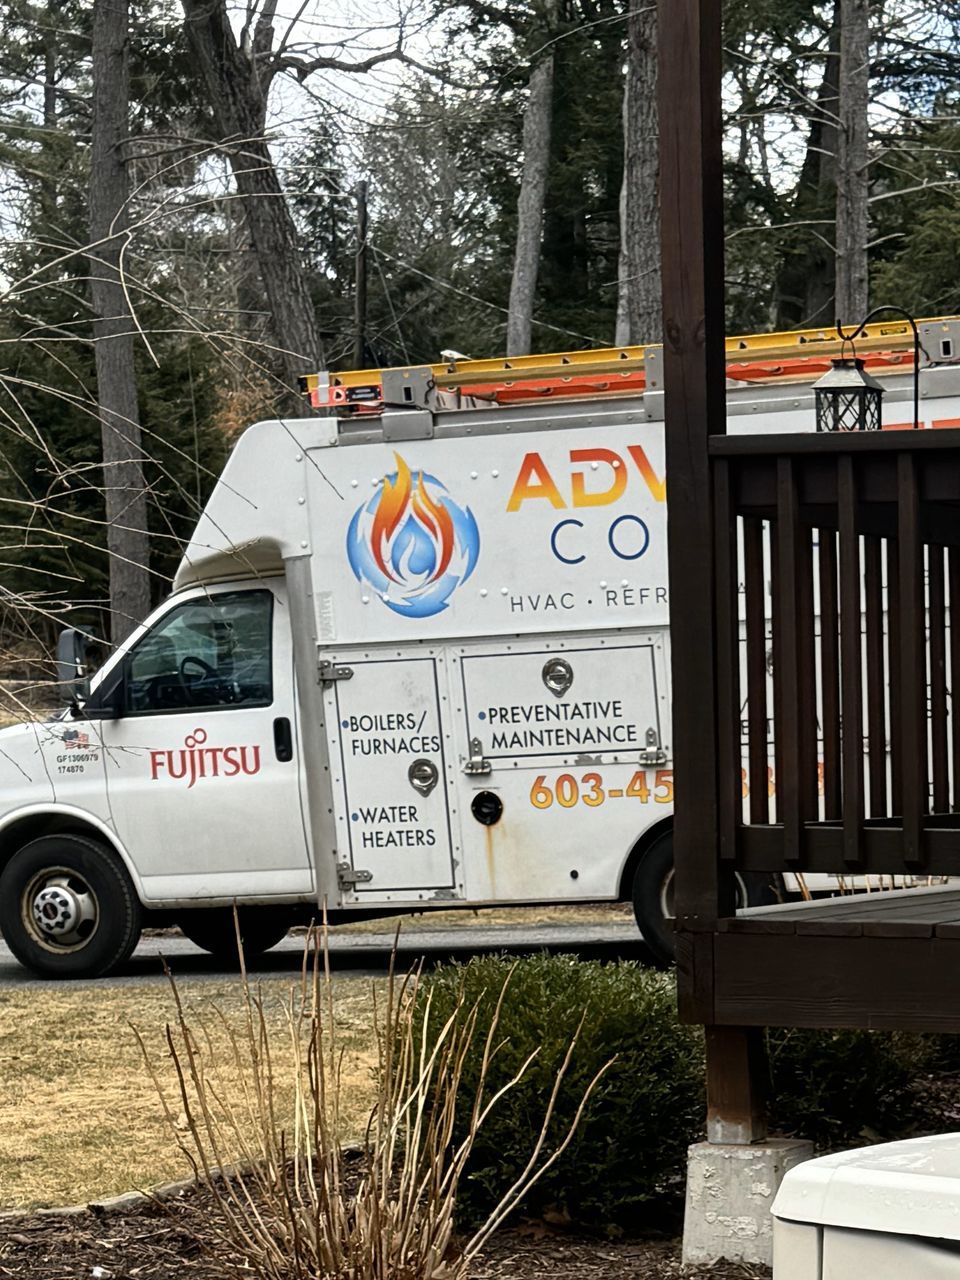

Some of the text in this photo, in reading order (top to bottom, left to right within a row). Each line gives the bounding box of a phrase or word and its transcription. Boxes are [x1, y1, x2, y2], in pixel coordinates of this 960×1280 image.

[510, 586, 668, 613] HVAC REFR
[349, 710, 428, 734] BOILERS/
[488, 700, 623, 725] PREVENTATIVE
[352, 735, 440, 756] FURNACES
[491, 724, 638, 750] MAINTENANCE
[150, 745, 260, 789] FUJITSU
[530, 769, 673, 809] 603-45
[359, 805, 419, 824] WATER
[362, 829, 436, 848] HEATERS
